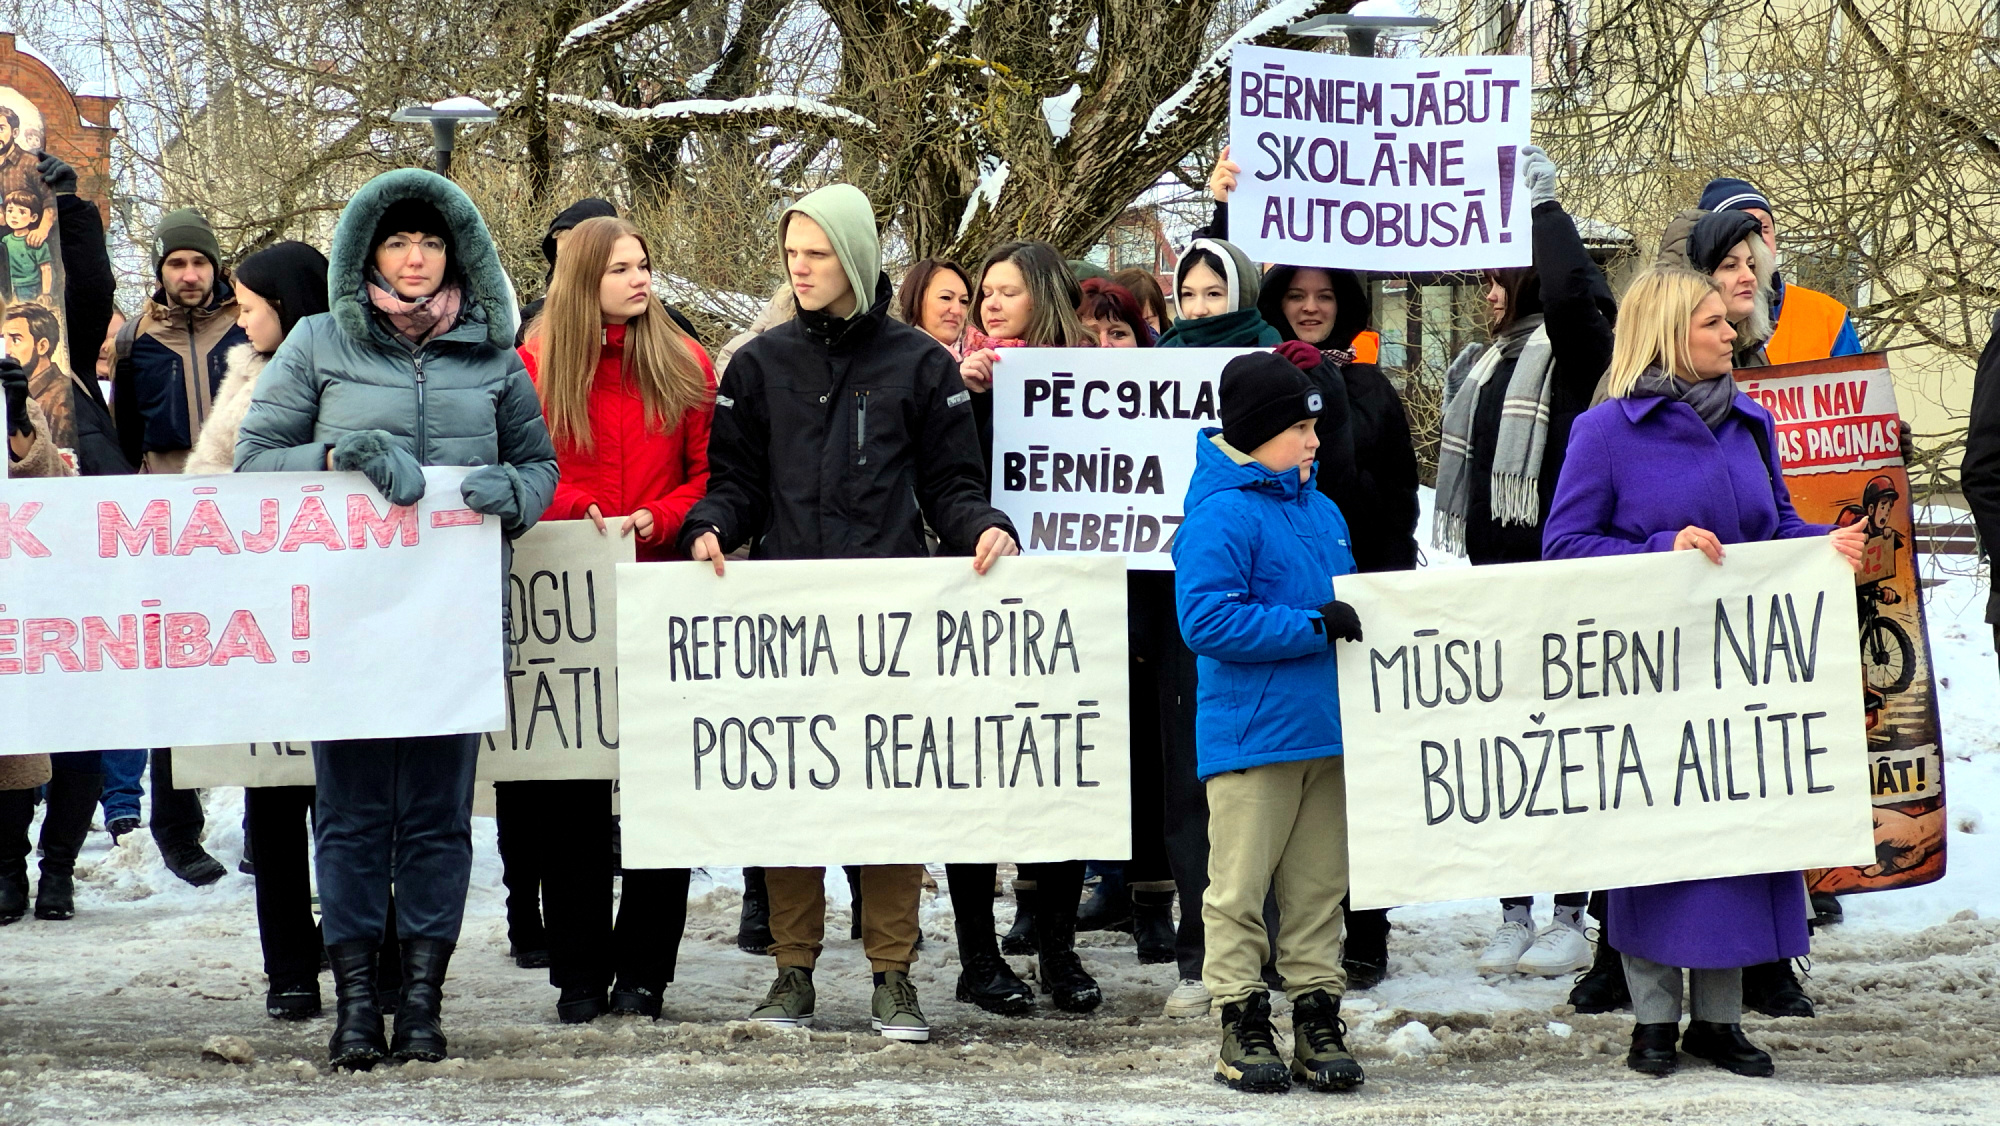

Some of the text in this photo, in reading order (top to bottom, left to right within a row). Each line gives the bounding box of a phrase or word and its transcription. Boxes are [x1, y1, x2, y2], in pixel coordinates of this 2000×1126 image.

[1240, 63, 1520, 127] BĒRNIEM JĀBŪT
[1254, 132, 1465, 186] SKOLĀ-NE
[1813, 381, 1868, 418] NAV
[1003, 445, 1165, 495] BĒRNĪBA
[1806, 419, 1899, 467] PACIŅAS
[669, 597, 1080, 681] REFORMA UZ PAPĪRA
[1369, 590, 1825, 713] MŪSU BĒRNI NAV
[693, 700, 1101, 790] POSTS REALITĀTĒ
[1420, 702, 1835, 826] BUDŽETA AILĪTE
